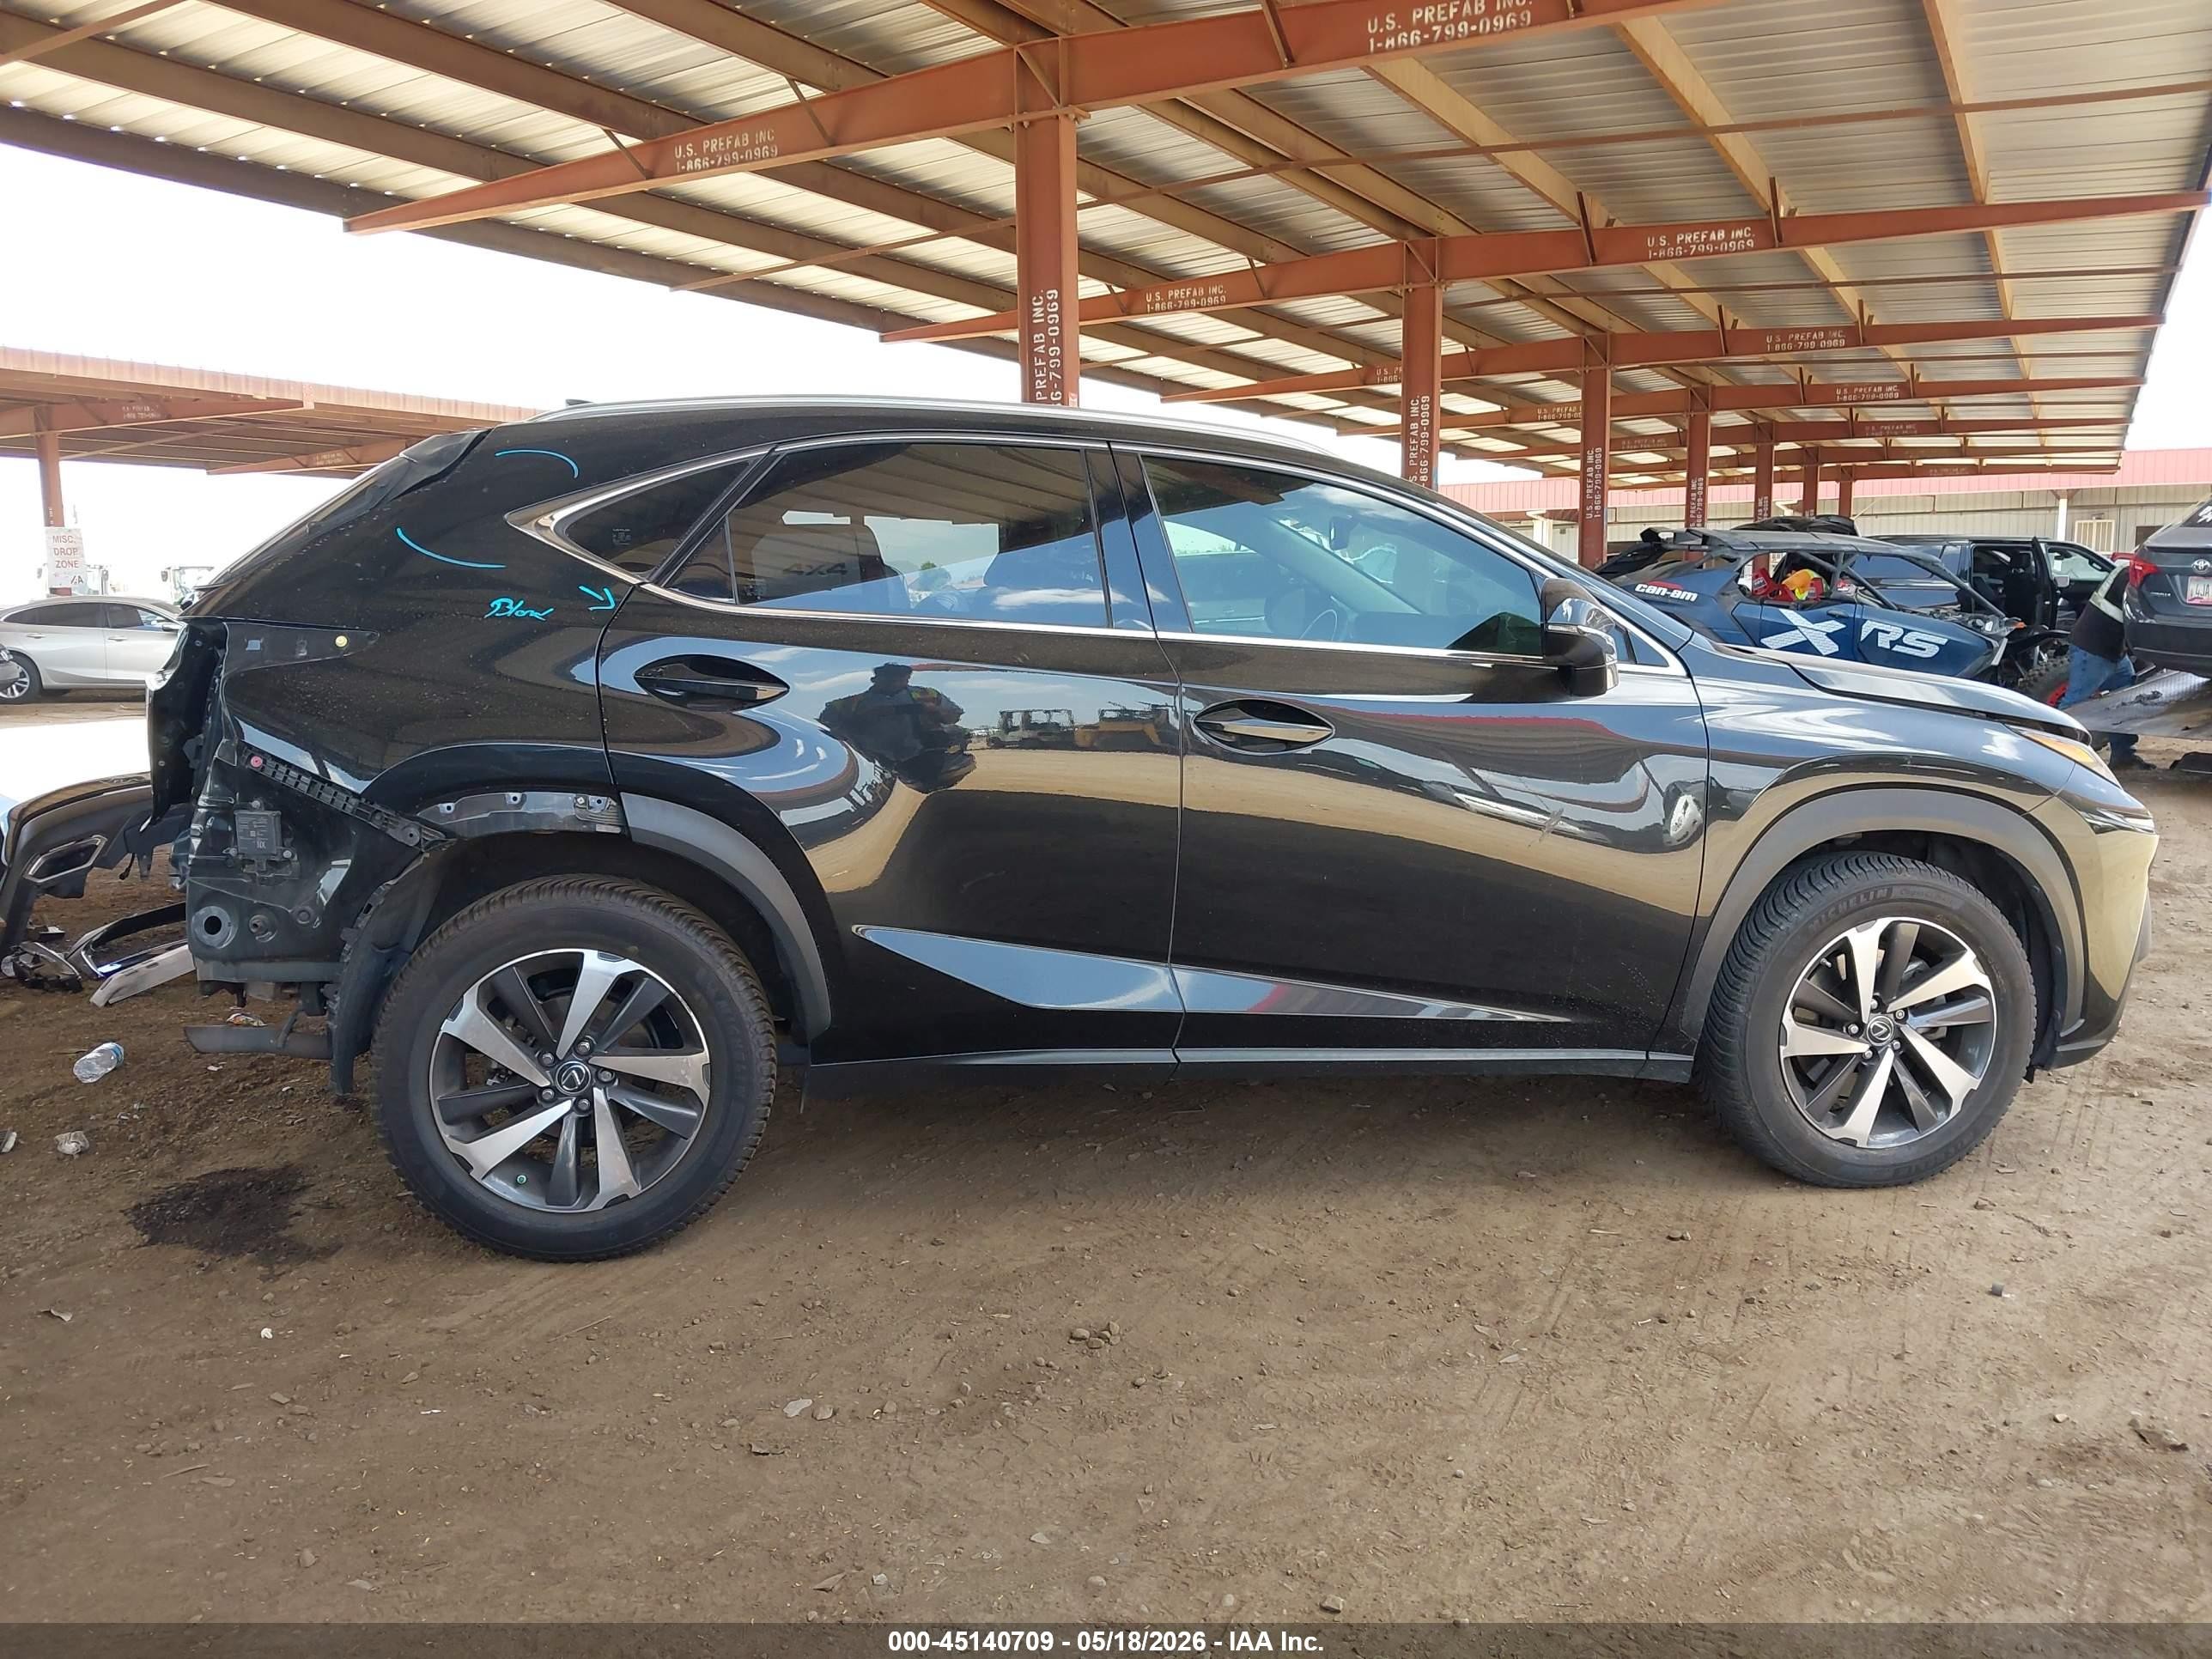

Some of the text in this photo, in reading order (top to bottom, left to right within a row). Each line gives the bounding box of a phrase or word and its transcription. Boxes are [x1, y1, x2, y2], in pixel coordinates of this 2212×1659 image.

[1368, 12, 1401, 33] U.S.
[1413, 0, 1486, 25] PREFAB
[1369, 9, 1532, 53] 1-866-799-0969
[674, 143, 697, 159] U.S.
[702, 132, 749, 154] PREFAB
[676, 144, 779, 173] 1-866-799-0969
[1676, 228, 1726, 245] PREFAB
[1168, 287, 1205, 301] PREFAB
[1208, 284, 1227, 295] INC.
[1146, 295, 1226, 313] 1-866-799-0969
[1031, 289, 1048, 400] PREFAB INC.
[1047, 289, 1062, 405] 6-799-0969
[1788, 330, 1825, 342] PREFAB
[1410, 395, 1420, 417] INC.
[1409, 422, 1419, 466] PREFAB
[52, 535, 76, 544] MISC.
[53, 547, 78, 556] DROP
[55, 560, 80, 568] ZONE
[1634, 583, 1698, 602] can-am
[1760, 608, 1948, 659] X RS
